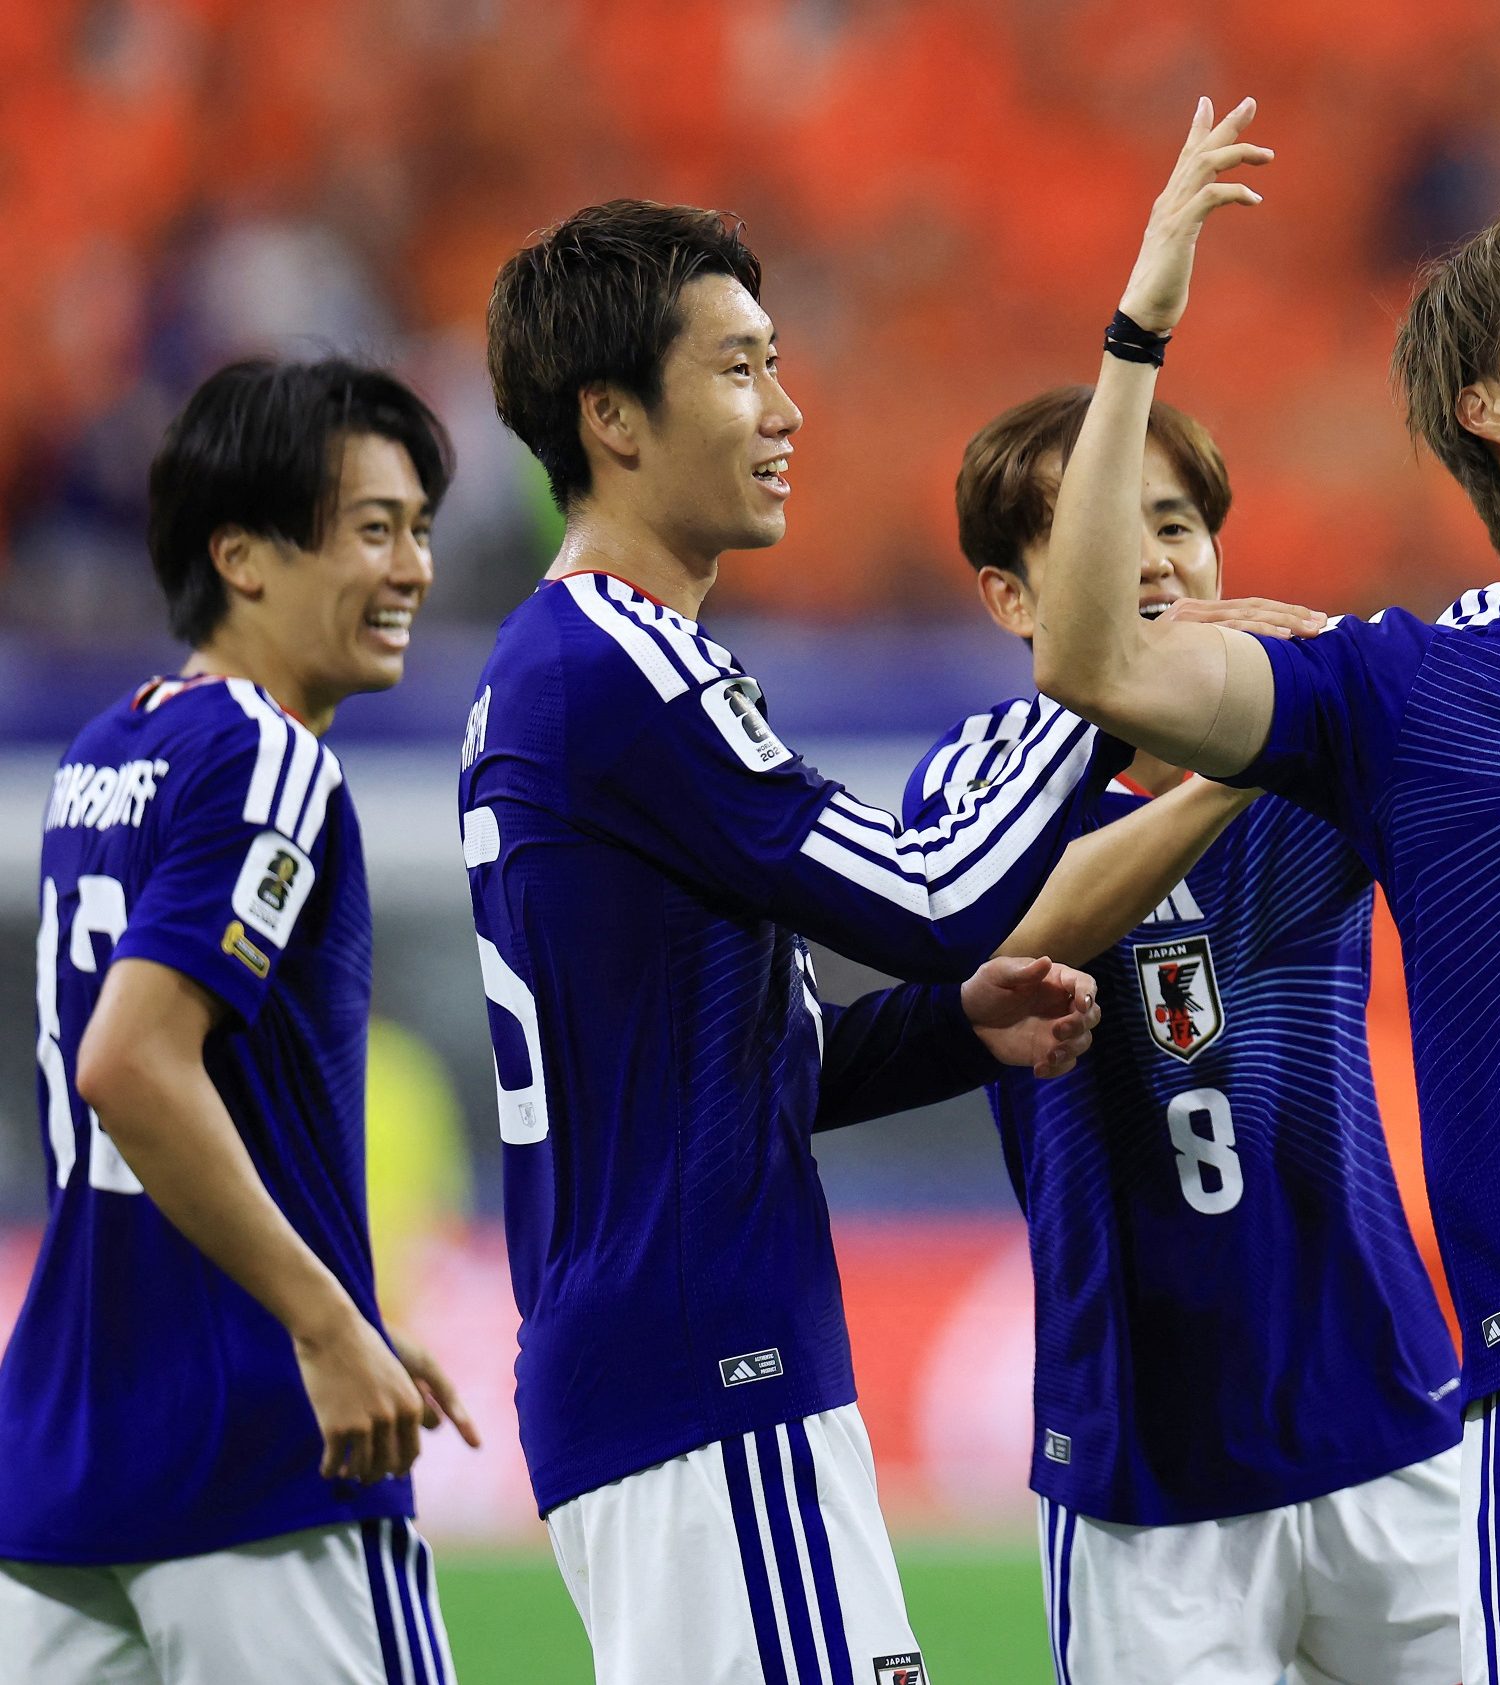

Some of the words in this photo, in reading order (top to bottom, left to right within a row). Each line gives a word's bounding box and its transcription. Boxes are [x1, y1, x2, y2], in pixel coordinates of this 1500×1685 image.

[760, 746, 784, 762] 202
[1148, 944, 1187, 959] JAPAN
[1166, 1020, 1202, 1042] JFA
[1167, 1088, 1244, 1215] 8
[885, 1656, 911, 1666] JAPAN
